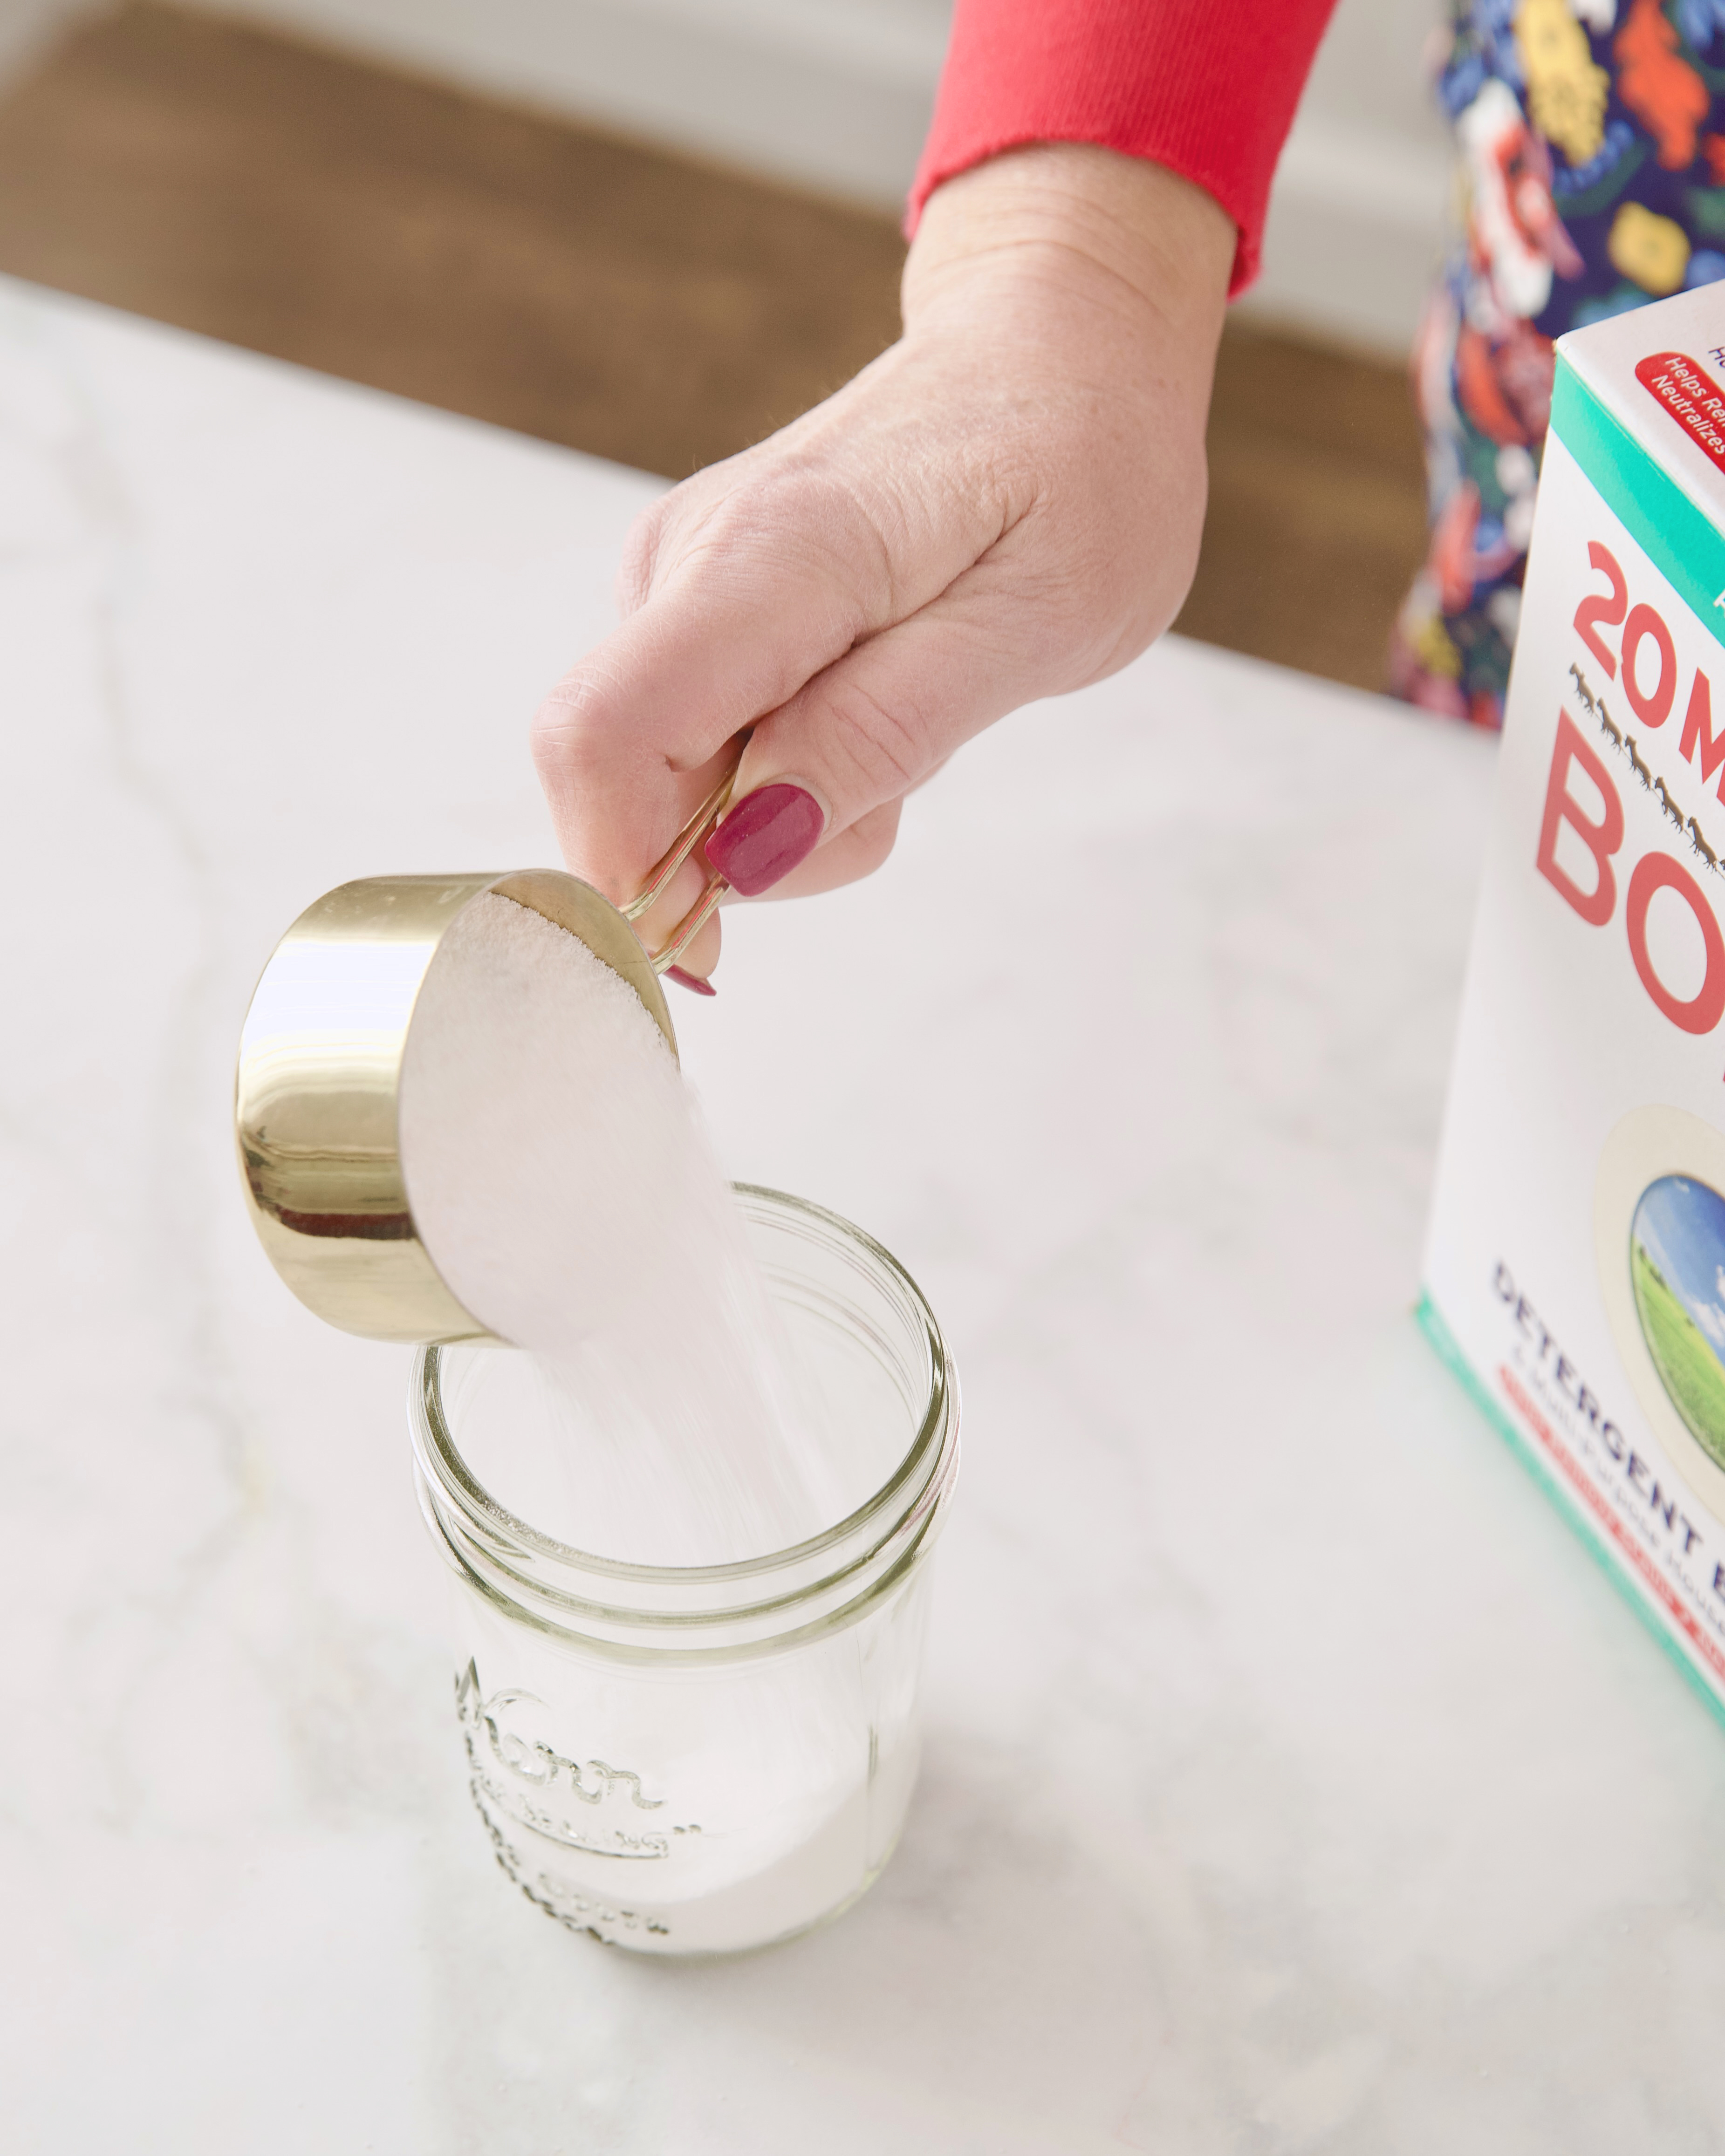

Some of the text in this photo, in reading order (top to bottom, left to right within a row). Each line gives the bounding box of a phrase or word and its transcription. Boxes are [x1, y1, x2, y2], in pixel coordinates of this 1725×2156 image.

[1651, 374, 1725, 455] Neutralizes
[1665, 357, 1707, 397] Helps
[1573, 540, 1677, 728] 20
[1536, 704, 1725, 1035] BO
[1492, 1257, 1704, 1556] DETERGENT
